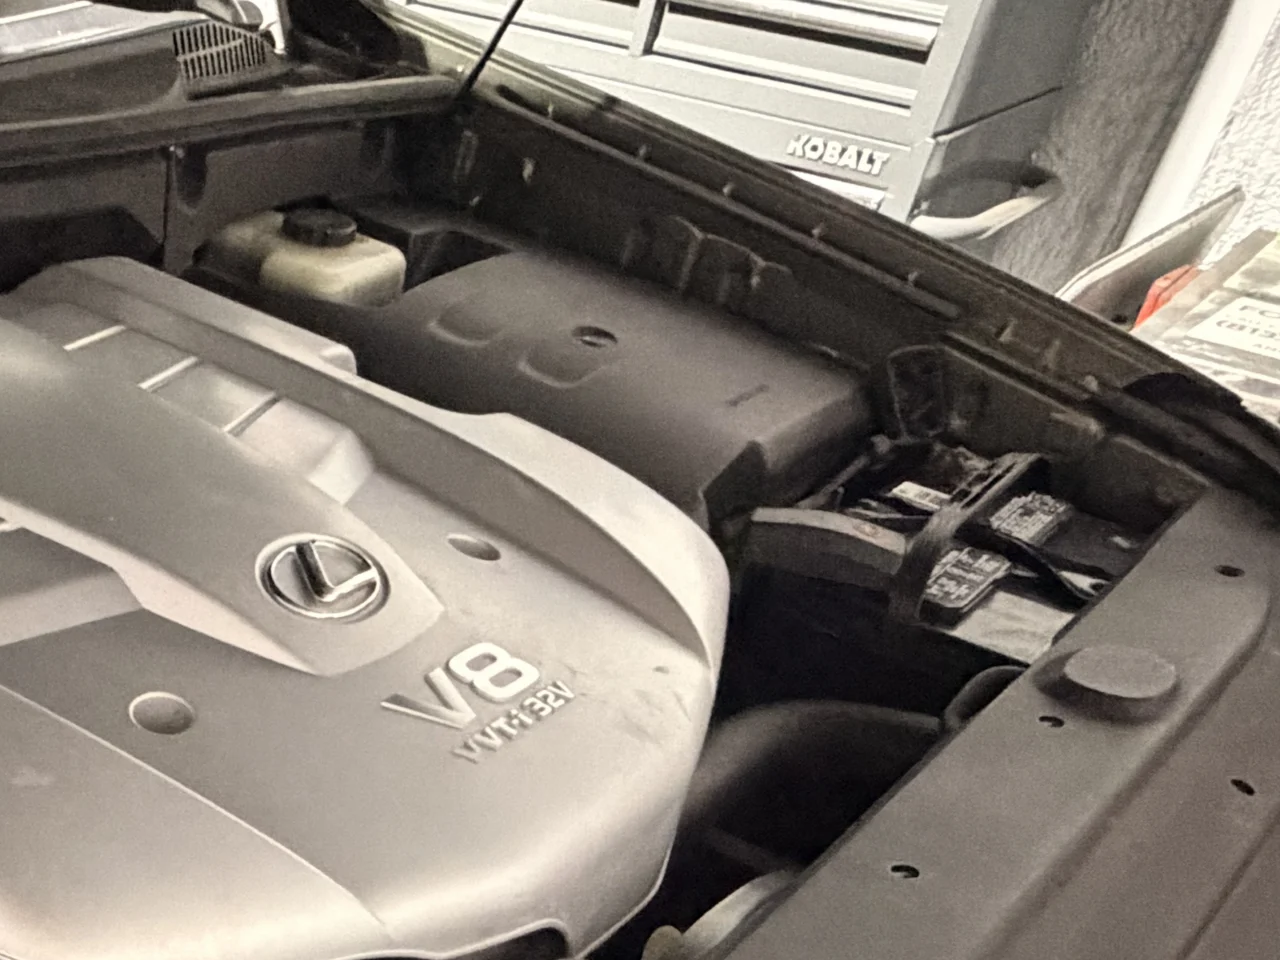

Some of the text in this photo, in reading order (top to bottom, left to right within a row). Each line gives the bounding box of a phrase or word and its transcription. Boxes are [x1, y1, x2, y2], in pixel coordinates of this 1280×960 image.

[785, 134, 891, 176] KOBALT
[380, 642, 541, 730] V8
[522, 680, 576, 722] 32V
